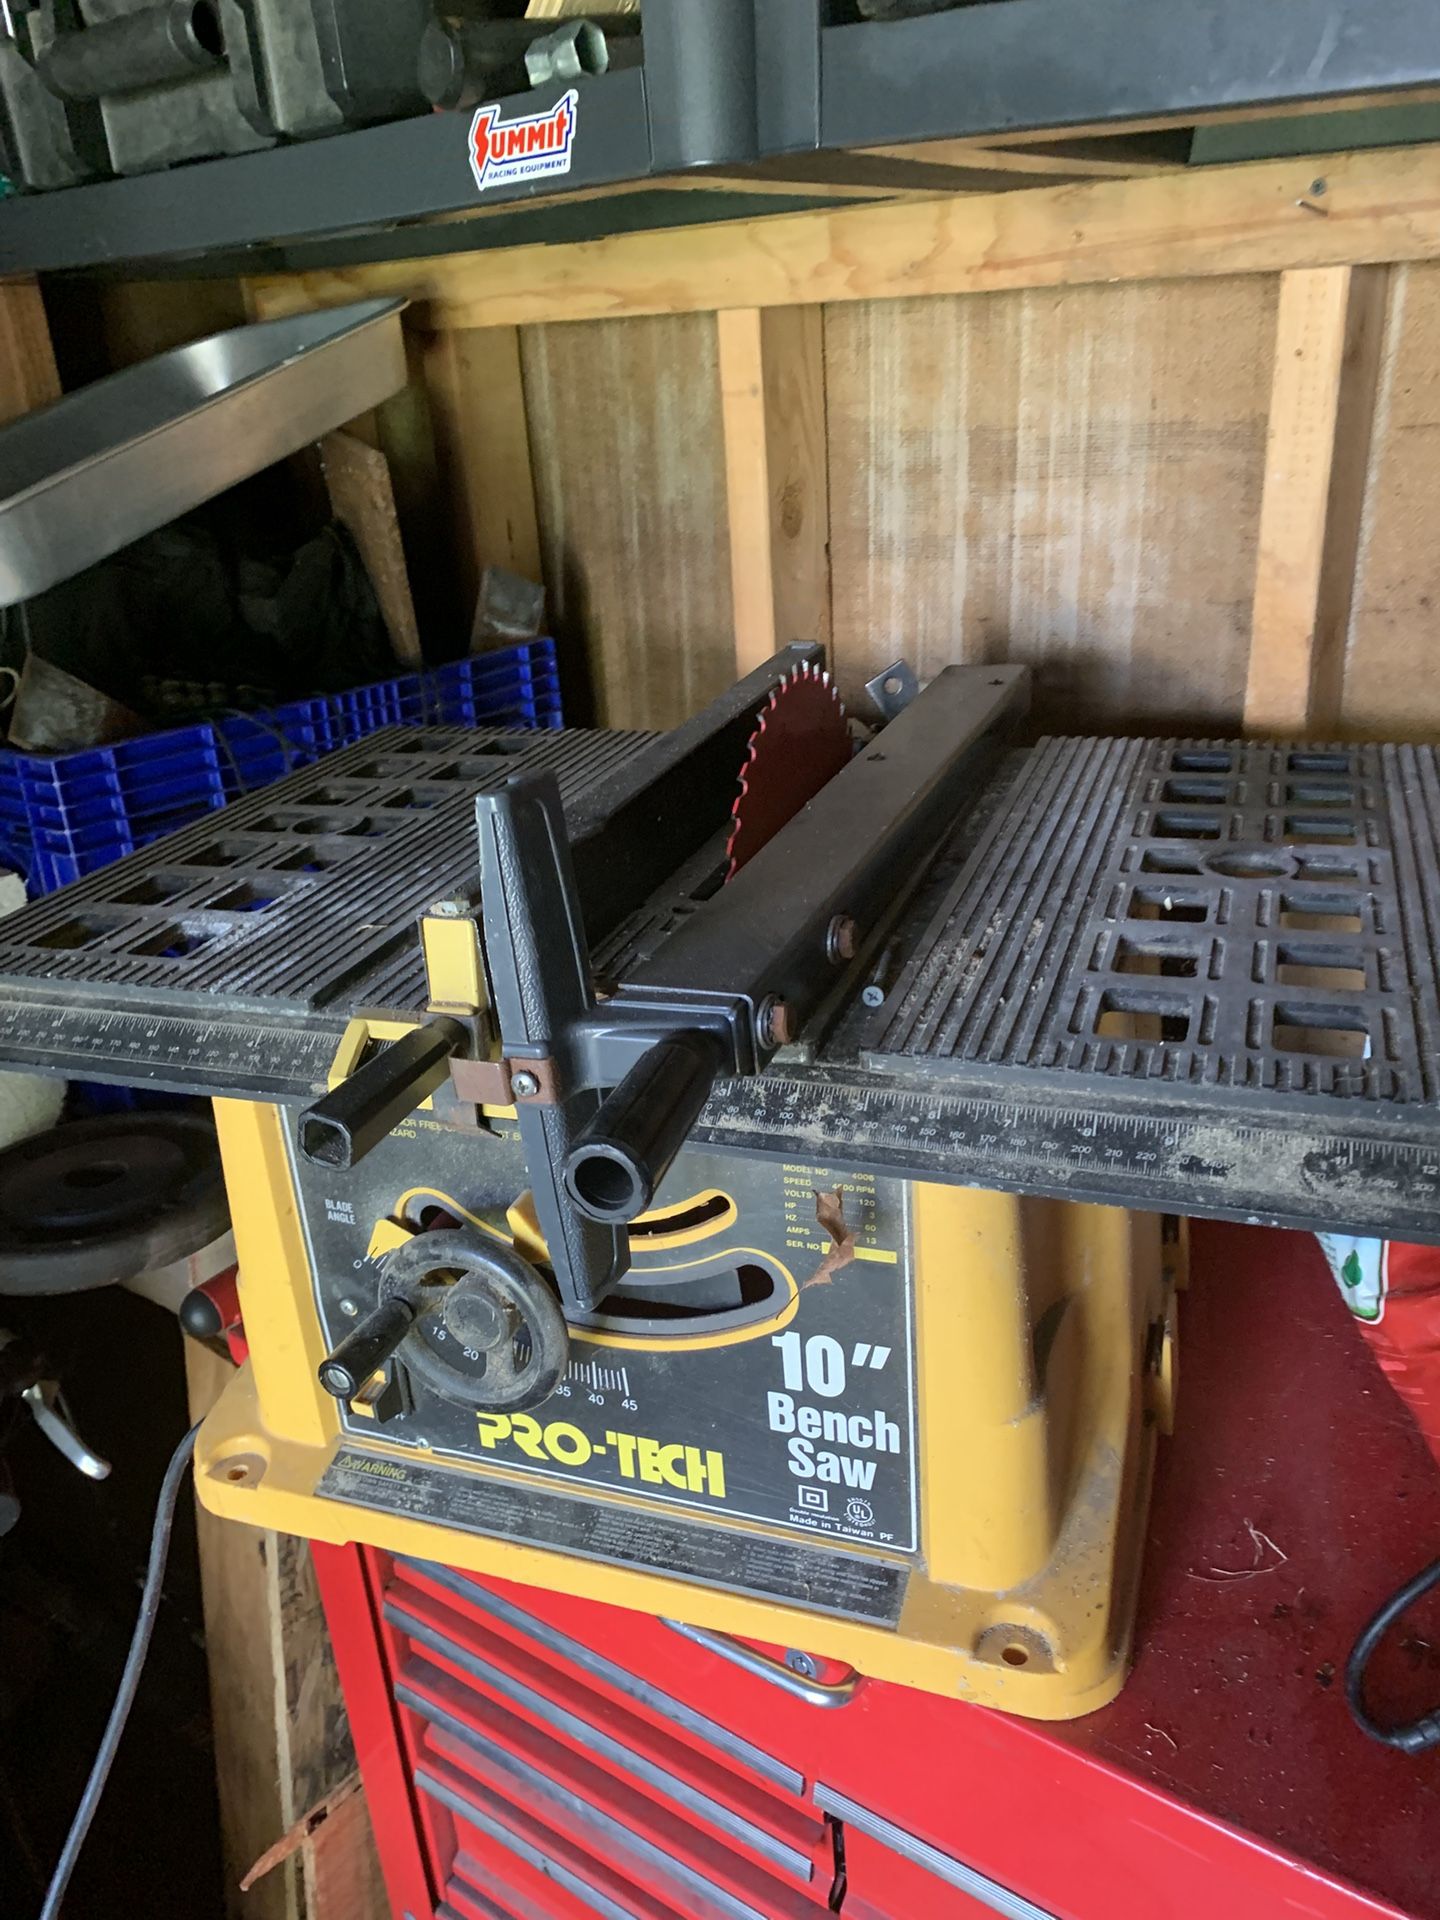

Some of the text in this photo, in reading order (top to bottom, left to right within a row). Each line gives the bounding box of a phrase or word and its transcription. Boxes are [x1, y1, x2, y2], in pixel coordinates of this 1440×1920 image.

[474, 109, 567, 170] SUMMIT
[488, 159, 567, 179] RACING EQUIPMENT
[727, 1105, 740, 1114] 80
[754, 1109, 767, 1117] 90
[778, 1111, 794, 1120] 100
[834, 1117, 850, 1127] 120
[862, 1121, 879, 1130] 130
[891, 1124, 907, 1134] 140
[919, 1127, 937, 1137] 150
[949, 1131, 966, 1140] 160
[980, 1134, 997, 1144] 170
[1010, 1137, 1027, 1147] 180
[1041, 1140, 1058, 1151] 190
[1070, 1144, 1092, 1155] 200
[1105, 1148, 1123, 1159] 210
[1136, 1151, 1157, 1162] 220
[1412, 1181, 1436, 1192] 300
[855, 1102, 865, 1111] 5
[927, 1110, 937, 1120] 6
[1002, 1118, 1012, 1128] 7
[1081, 1127, 1092, 1137] 8
[1422, 1164, 1439, 1176] 12
[782, 1163, 813, 1175] MODEL
[814, 1167, 829, 1176] NO
[783, 1176, 812, 1187] SPEED
[856, 1184, 875, 1195] RPM
[324, 1198, 355, 1214] BLADE
[784, 1189, 876, 1208] VOLTS 120
[327, 1211, 357, 1225] ANGLE
[784, 1201, 876, 1220] HP 3
[785, 1213, 877, 1233] HZ 60
[786, 1225, 877, 1245] AMPS 13
[352, 1259, 363, 1270] 0
[431, 1326, 639, 1412] 15 20 35 40 45
[771, 1331, 892, 1398] 10"
[767, 1391, 901, 1454] Bench
[476, 1411, 726, 1499] PRO-TECH
[787, 1437, 878, 1492] Saw
[351, 1459, 407, 1480] WARNING
[852, 1504, 868, 1520] UL
[789, 1513, 818, 1526] Made
[821, 1520, 832, 1529] in
[834, 1522, 874, 1538] Taiwan
[879, 1532, 894, 1542] PF
